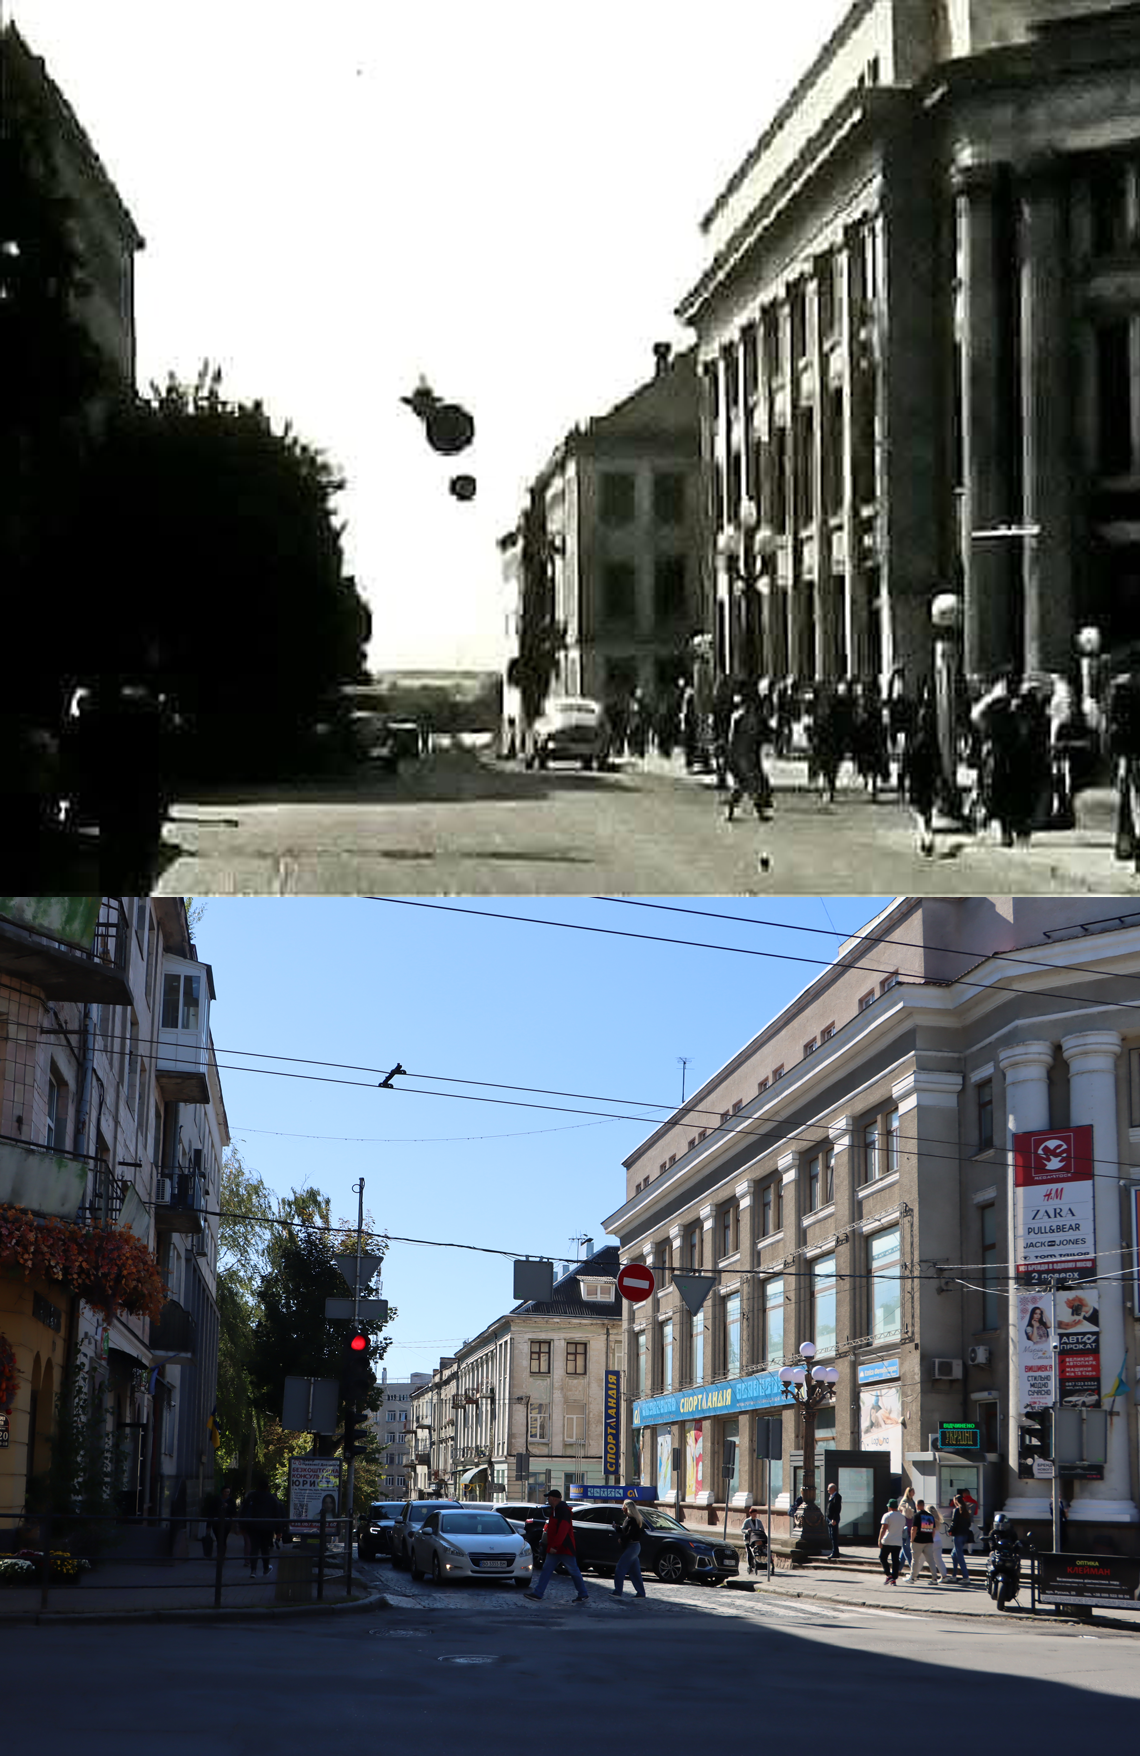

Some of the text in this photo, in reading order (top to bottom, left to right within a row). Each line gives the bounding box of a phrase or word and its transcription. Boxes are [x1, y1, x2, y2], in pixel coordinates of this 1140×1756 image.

[1043, 1187, 1064, 1202] H&M
[1031, 1207, 1076, 1220] ZARA
[1027, 1223, 1080, 1235] PULL&BEAR
[1032, 1273, 1038, 1282] 2
[680, 1388, 732, 1413] СПОРТЛАНДІЯ
[606, 1374, 617, 1471] СПОРТЛАНДІЯ
[1067, 1566, 1111, 1576] КЛЕЙМАН
